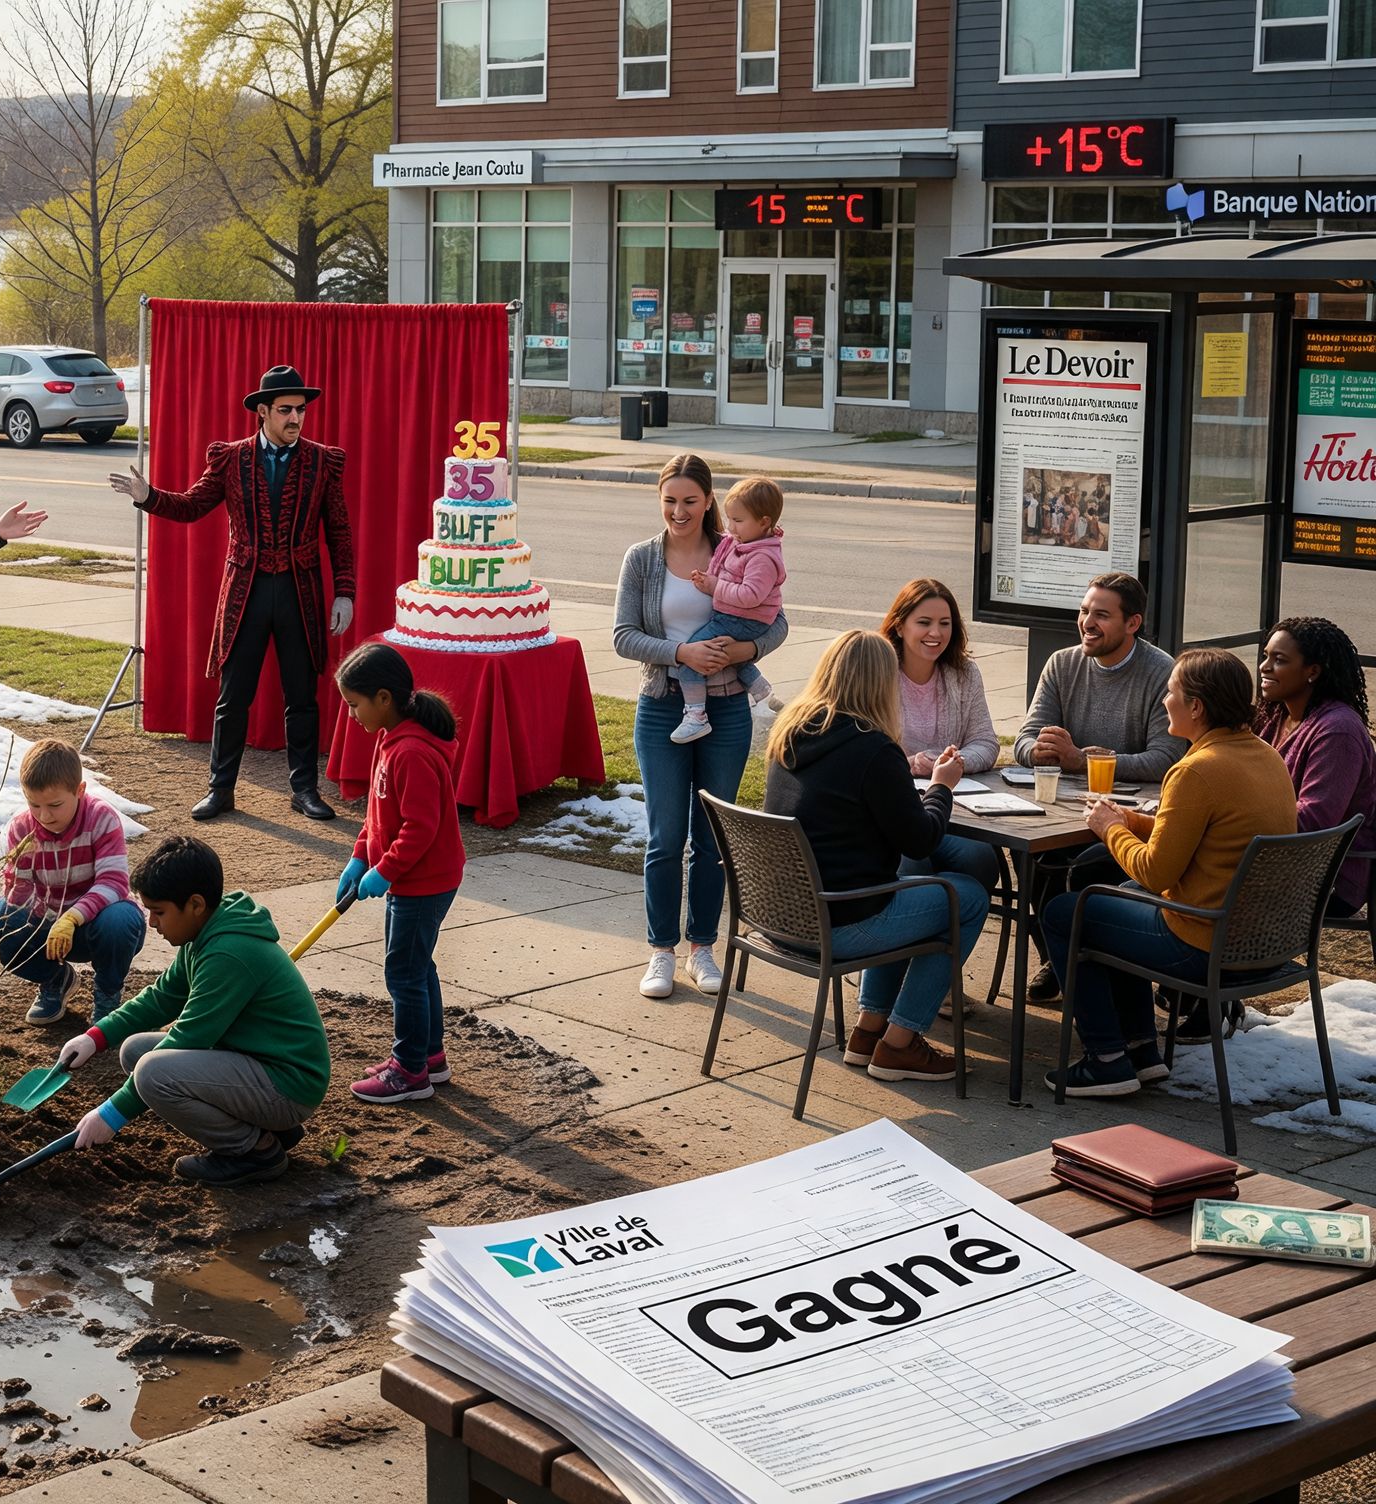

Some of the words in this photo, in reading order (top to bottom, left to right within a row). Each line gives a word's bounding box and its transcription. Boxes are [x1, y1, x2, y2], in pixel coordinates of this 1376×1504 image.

[1026, 125, 1145, 173] +15°C
[382, 162, 450, 179] Pharmacie
[452, 161, 483, 181] Jean
[486, 159, 524, 176] Coutu
[749, 194, 786, 224] 15
[1213, 189, 1298, 218] Banque
[1305, 189, 1376, 213] Nation
[1008, 345, 1041, 375] Le
[1044, 346, 1135, 379] Devoir
[452, 420, 501, 459] 35
[447, 465, 496, 501] 35
[544, 1225, 611, 1246] Ville
[614, 1215, 648, 1232] de
[558, 1229, 665, 1266] Laval
[686, 1223, 1021, 1353] Gagné
